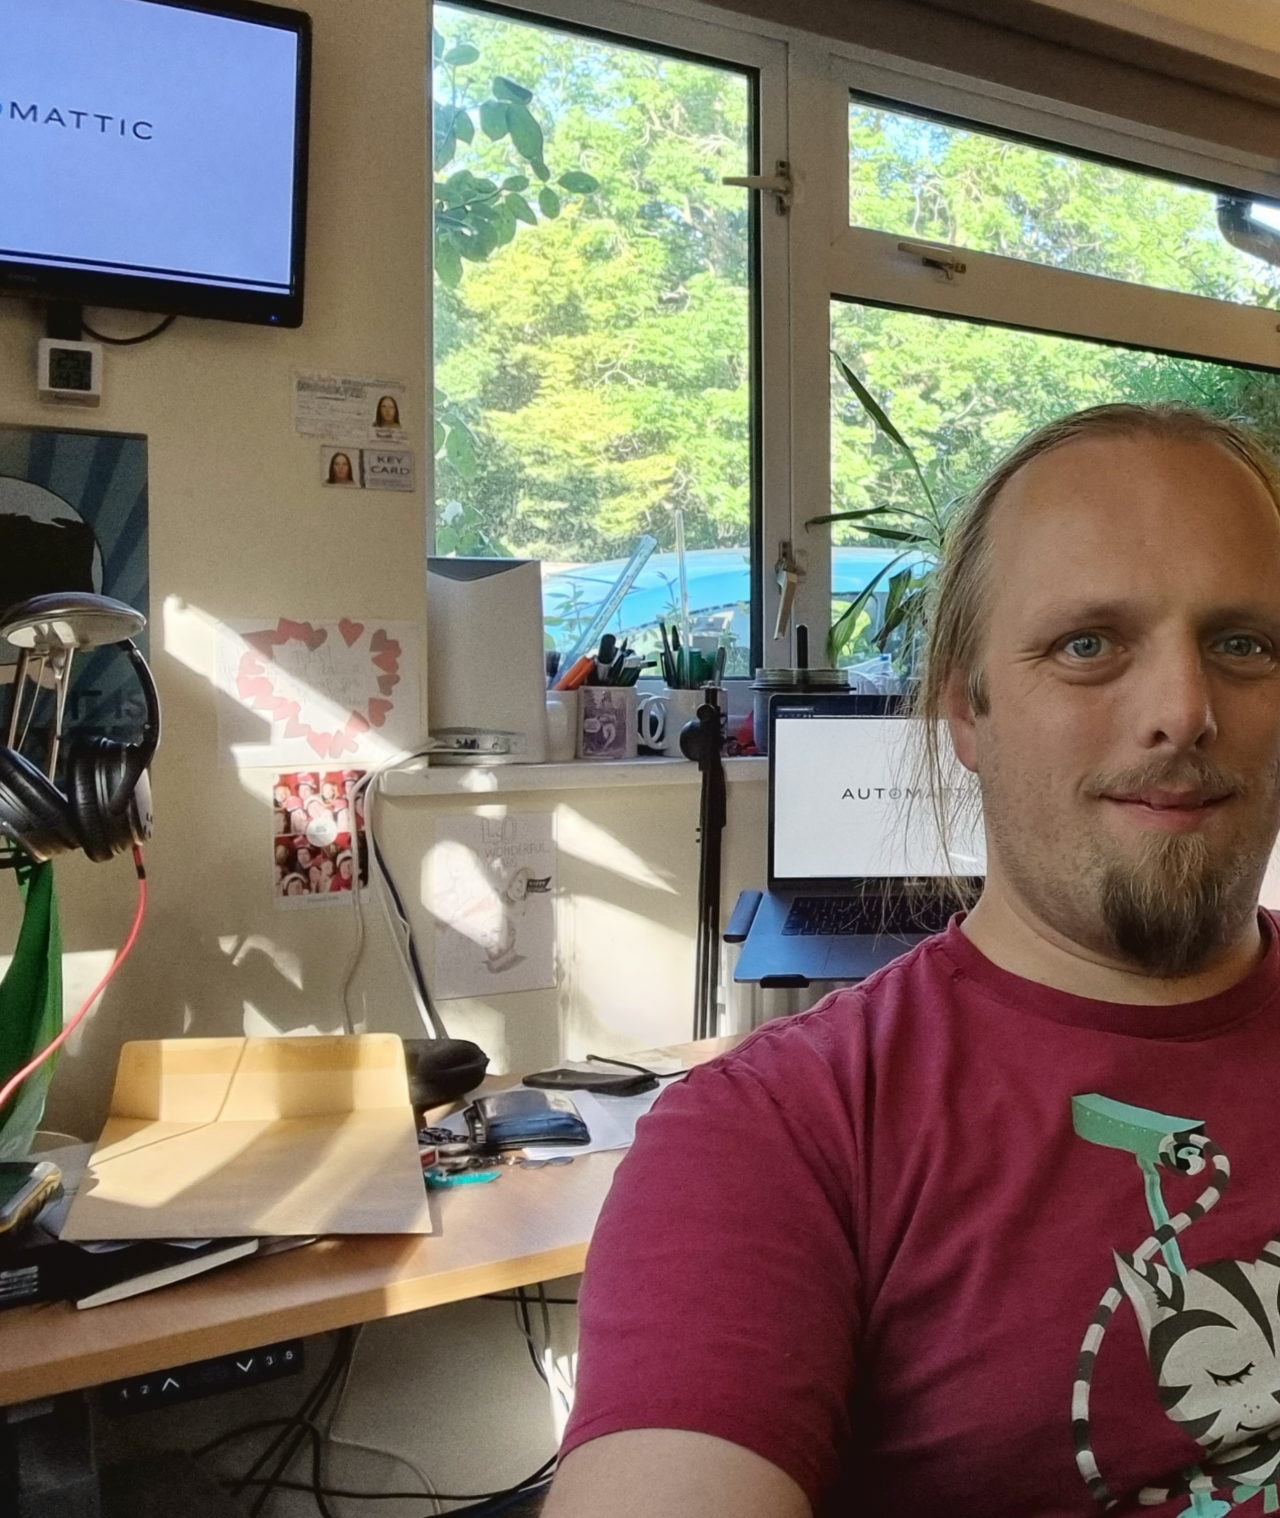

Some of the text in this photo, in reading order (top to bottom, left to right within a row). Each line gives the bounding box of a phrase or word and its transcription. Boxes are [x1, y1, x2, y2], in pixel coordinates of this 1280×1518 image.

[0, 101, 153, 140] MATTIC
[376, 455, 404, 464] KEY
[370, 465, 410, 475] CARD
[841, 787, 977, 801] AUTOMATT
